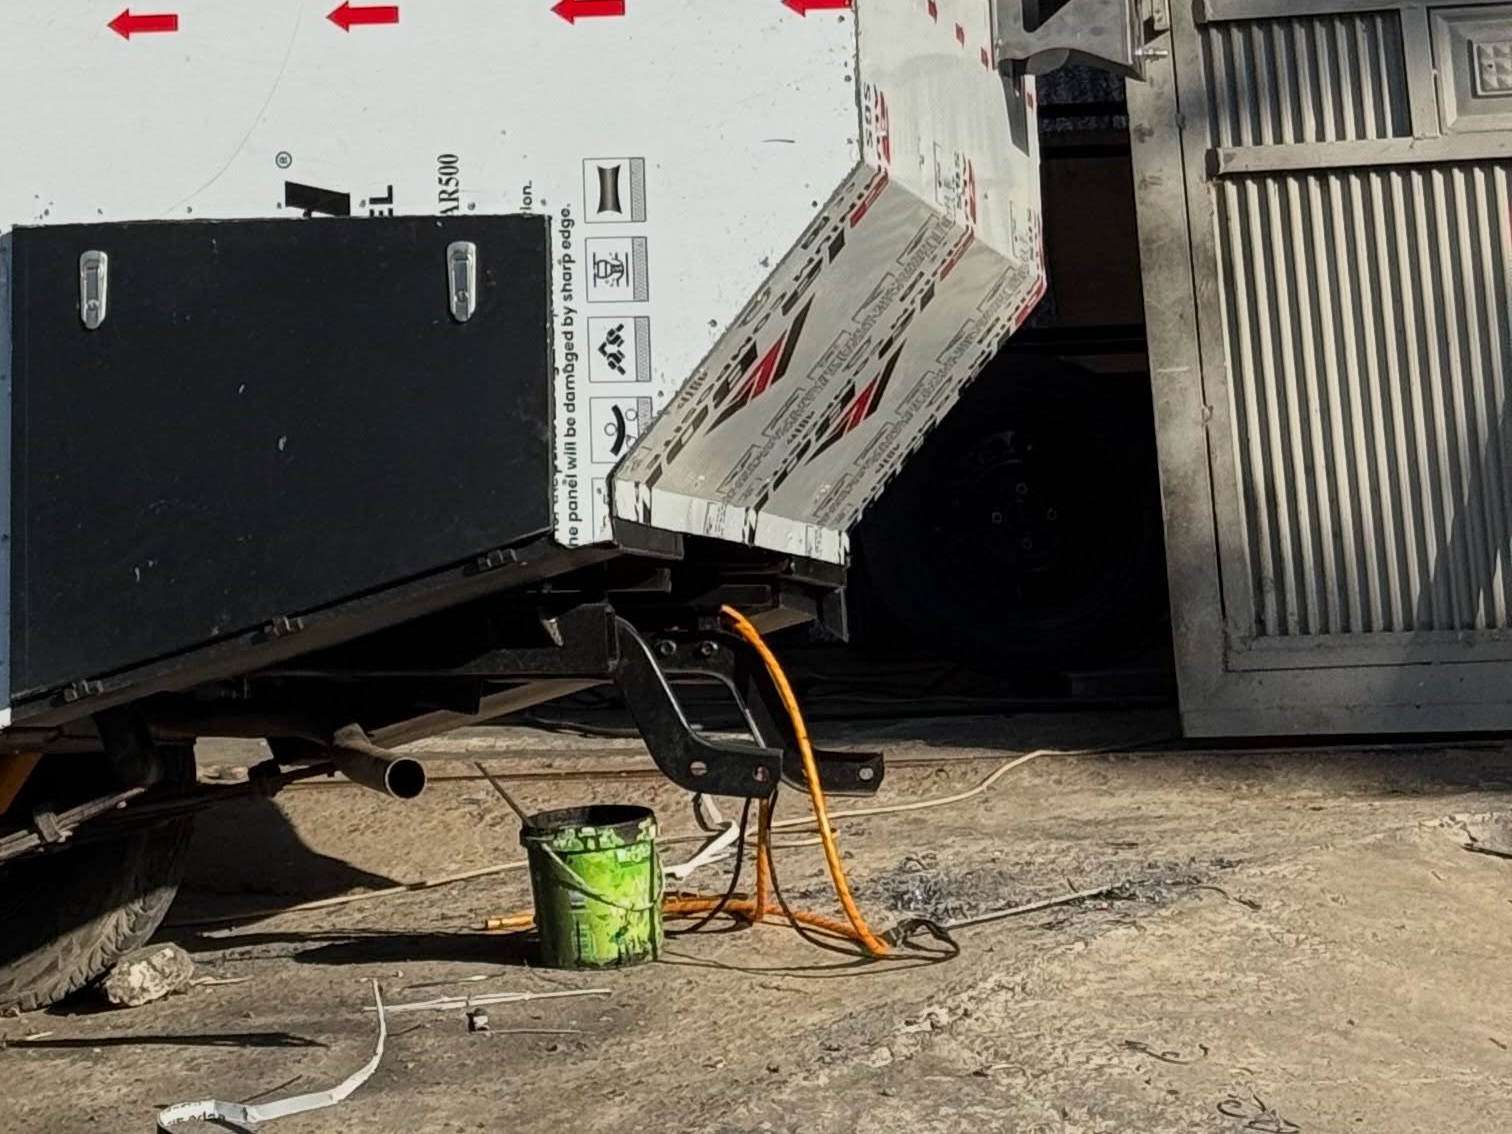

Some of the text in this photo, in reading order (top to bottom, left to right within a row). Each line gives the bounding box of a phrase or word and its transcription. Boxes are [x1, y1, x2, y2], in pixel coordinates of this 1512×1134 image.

[558, 203, 575, 250] edge.
[558, 253, 576, 302] sharp
[561, 306, 578, 328] by
[561, 331, 579, 414] damaged
[563, 417, 577, 438] be
[562, 440, 577, 471] will
[563, 474, 583, 522] panel
